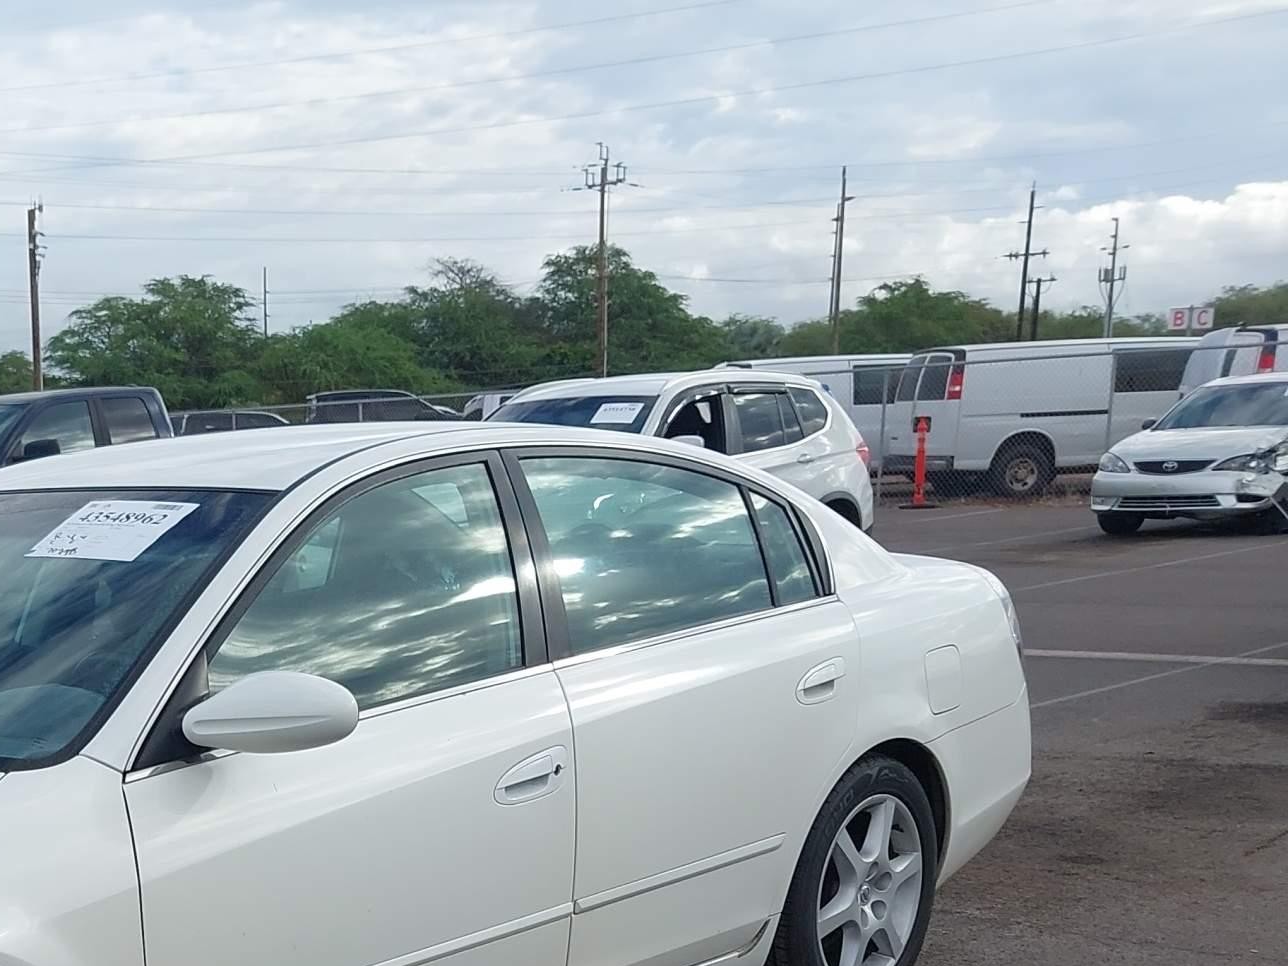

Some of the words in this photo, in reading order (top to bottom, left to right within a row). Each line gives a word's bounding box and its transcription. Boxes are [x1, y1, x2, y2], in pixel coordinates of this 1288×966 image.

[1173, 310, 1185, 327] B
[1197, 309, 1209, 326] C
[79, 511, 168, 525] 43548962
